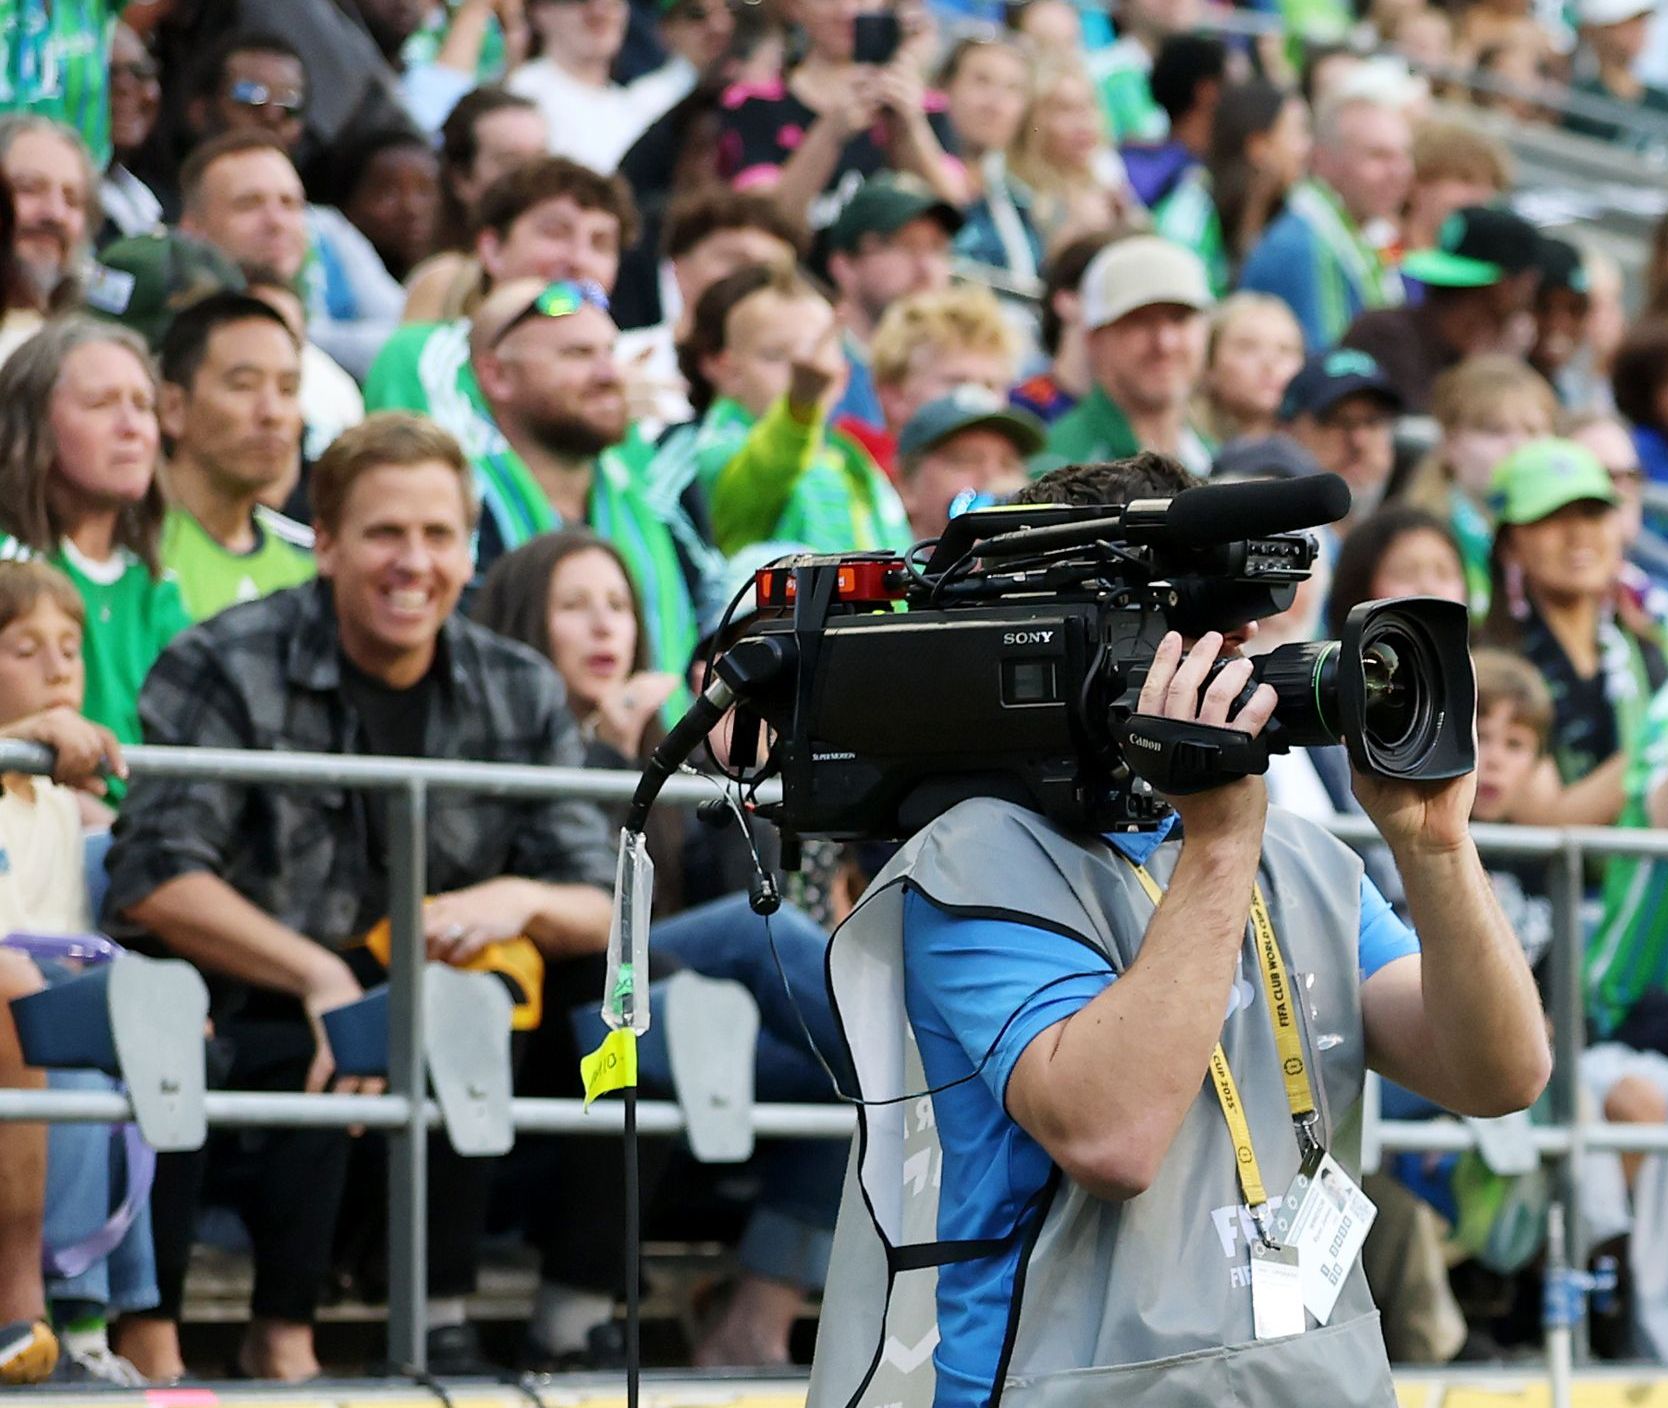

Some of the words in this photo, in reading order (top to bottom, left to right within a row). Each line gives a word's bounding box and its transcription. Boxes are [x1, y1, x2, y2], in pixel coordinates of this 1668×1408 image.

[1003, 630, 1054, 645] SONY
[1128, 732, 1162, 752] Canon
[1262, 930, 1279, 971] WORLD
[1270, 972, 1284, 1002] CLUB
[1277, 1003, 1290, 1028] FIFA
[1213, 1054, 1225, 1078] CUP
